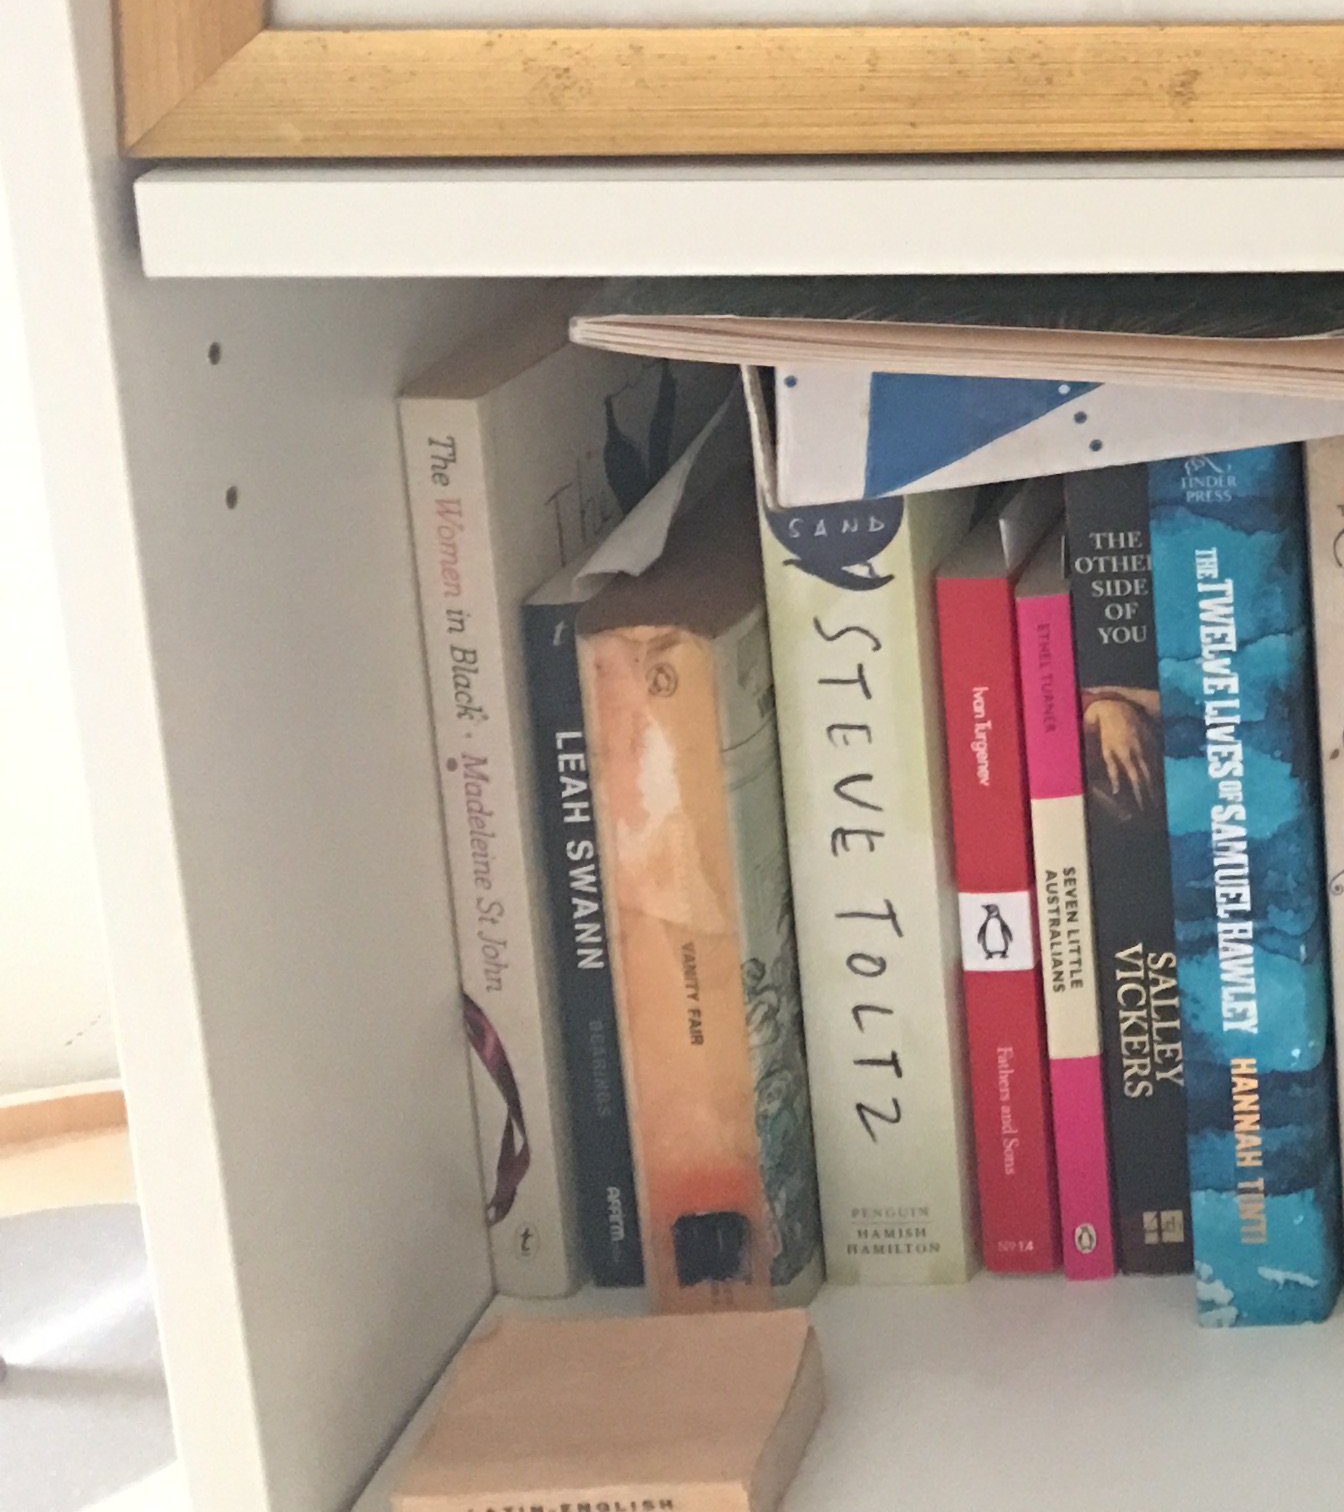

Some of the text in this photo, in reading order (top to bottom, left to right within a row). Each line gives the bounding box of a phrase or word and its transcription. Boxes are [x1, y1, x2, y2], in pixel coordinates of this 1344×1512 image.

[1089, 531, 1144, 550] THE
[1186, 490, 1233, 504] PRESS
[1091, 579, 1150, 599] SIDE
[1097, 626, 1148, 646] YOU
[1104, 603, 1139, 622] OF
[972, 720, 994, 788] Turgenev
[554, 730, 605, 971] LEAH SWANN
[812, 615, 904, 1144] STEVE TOLTZ
[1045, 869, 1067, 995] AUSTRALIANS
[1063, 866, 1084, 990] SEVEN LITTLE
[1210, 805, 1259, 1035] SAMUEL RAWLEY
[681, 942, 705, 1047] VANITY FAIR
[1114, 942, 1154, 1100] VICKERS
[1147, 950, 1185, 1088] SALLEY
[1231, 1057, 1263, 1168] HANNAH
[846, 1242, 941, 1256] HAMILTON
